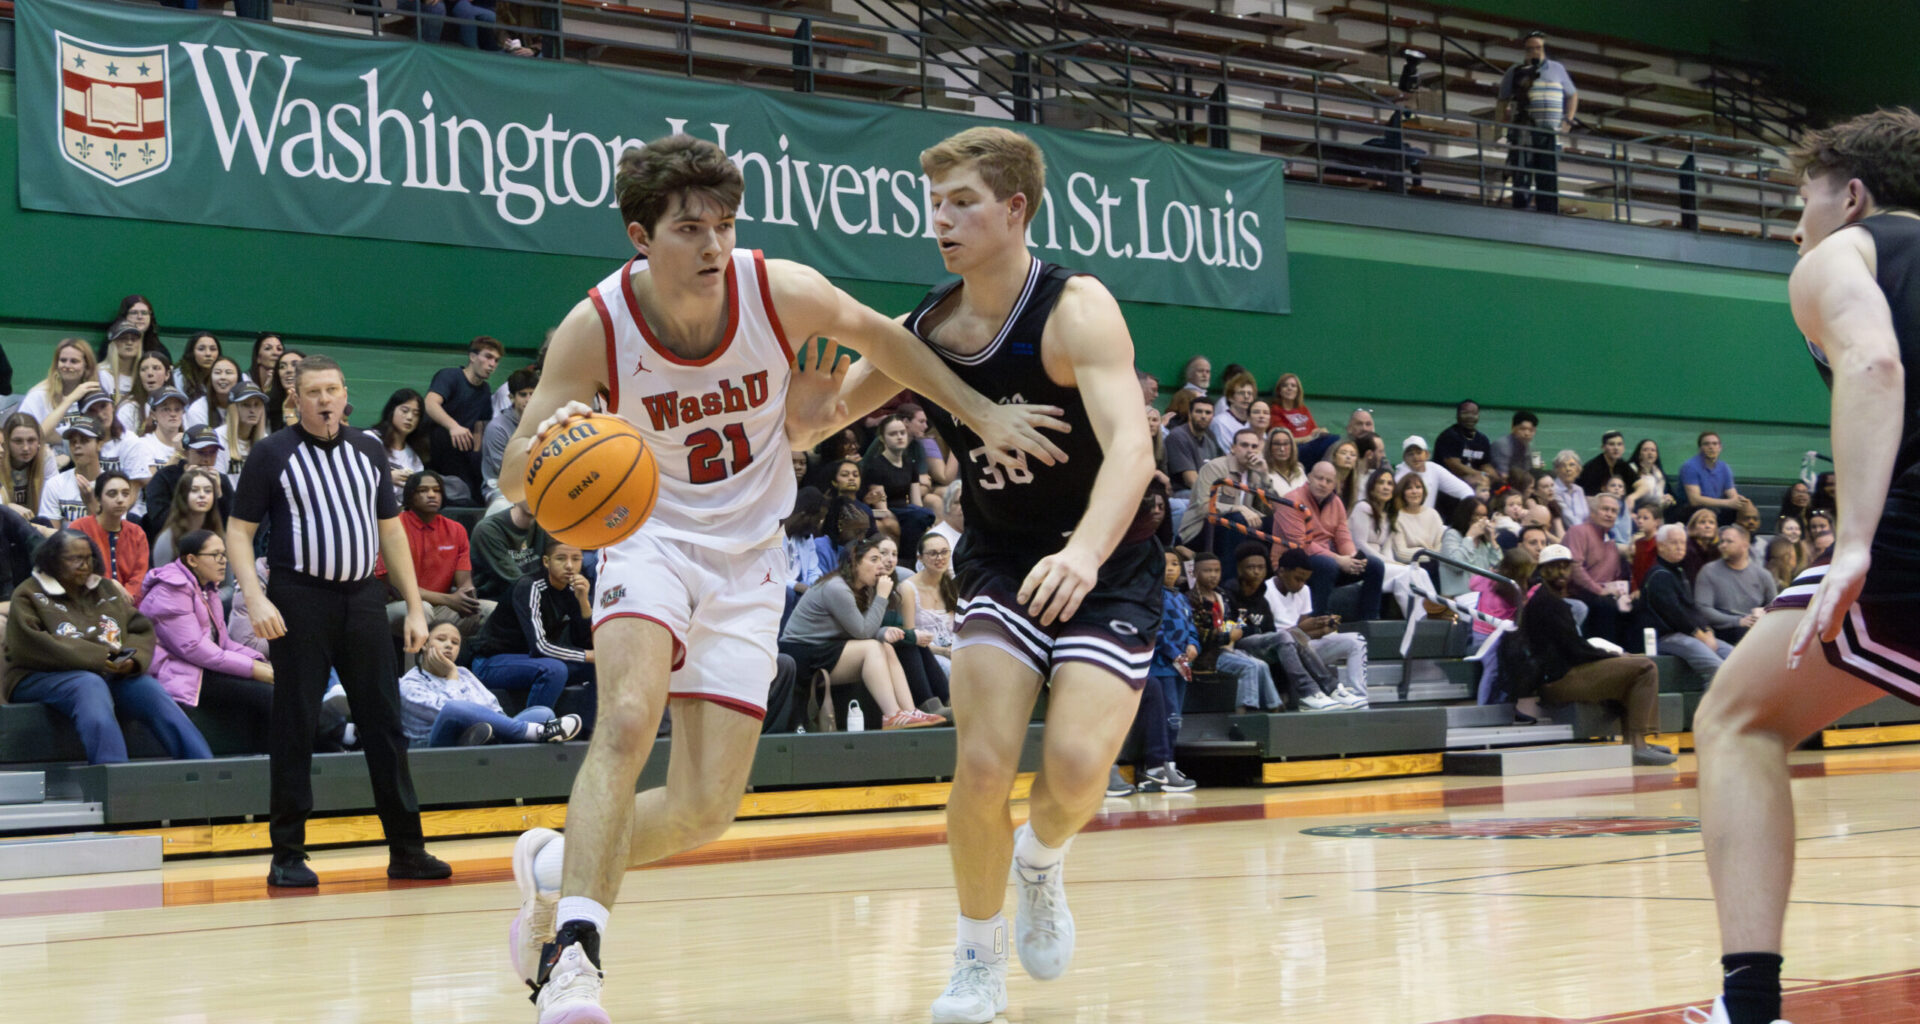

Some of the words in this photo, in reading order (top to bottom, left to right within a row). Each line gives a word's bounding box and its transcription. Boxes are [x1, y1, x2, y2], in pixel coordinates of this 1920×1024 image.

[641, 370, 768, 431] WashU
[527, 422, 599, 486] Wilson
[684, 422, 754, 485] 21
